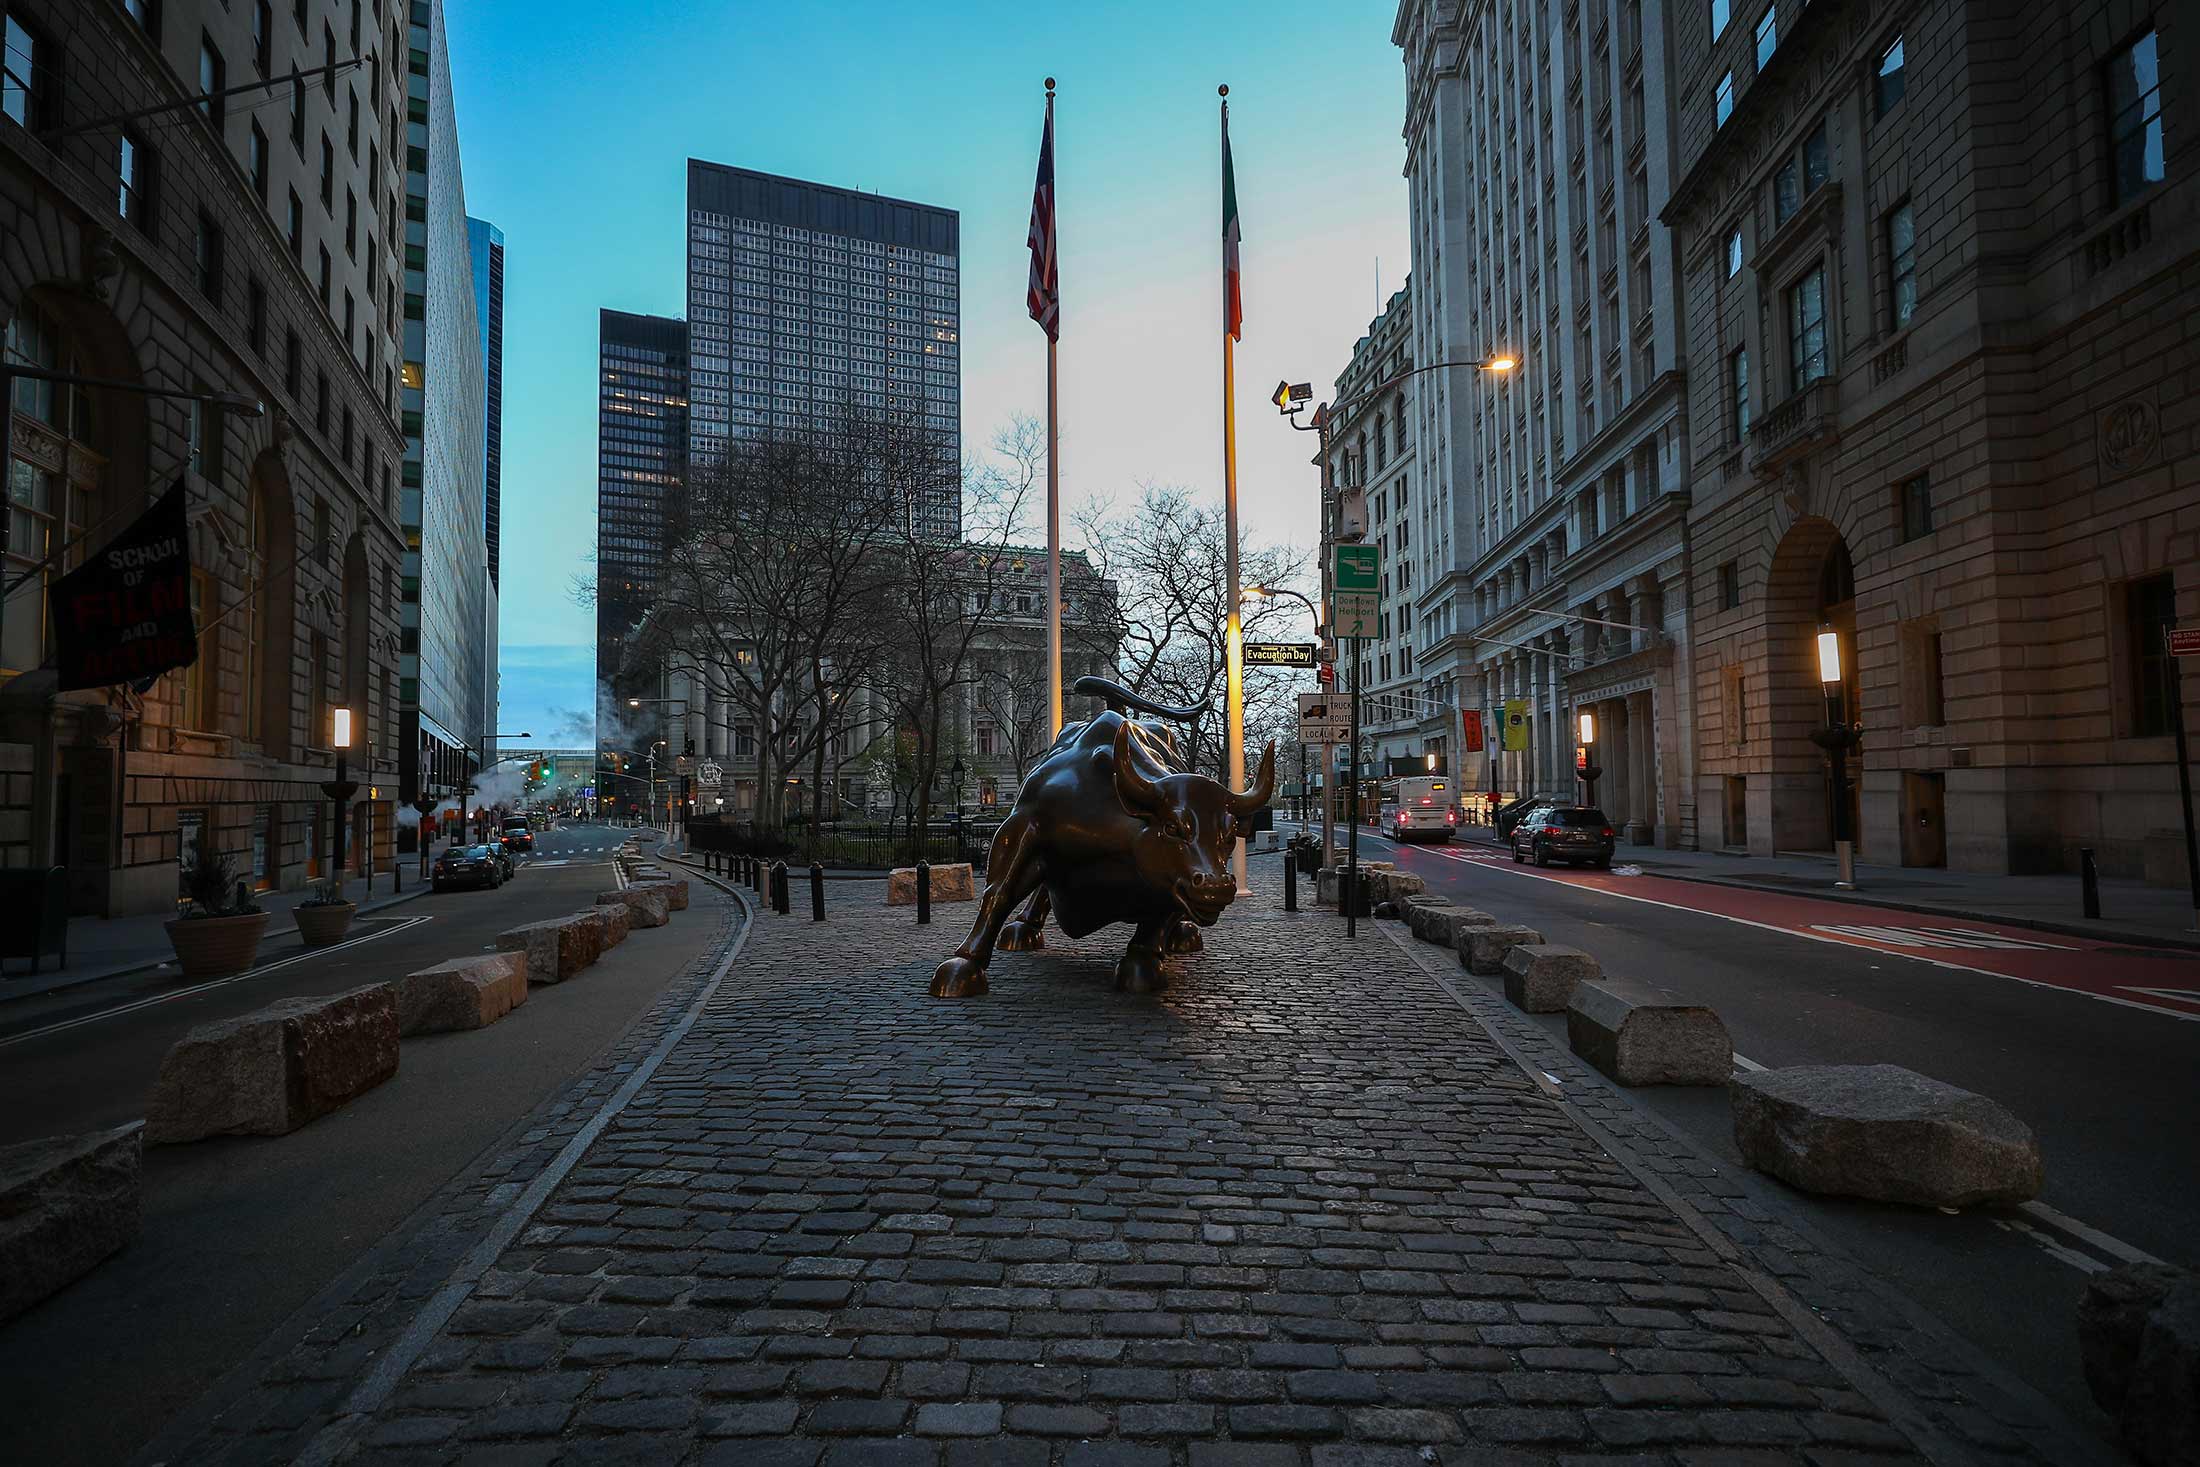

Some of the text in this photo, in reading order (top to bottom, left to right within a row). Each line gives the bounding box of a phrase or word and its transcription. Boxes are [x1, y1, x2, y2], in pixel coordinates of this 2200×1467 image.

[107, 537, 180, 569] SCHOOL
[123, 569, 145, 587] OF
[1247, 649, 1293, 660] Evacuation
[1294, 650, 1309, 662] Day
[1330, 702, 1353, 710] TRUCK
[1330, 714, 1353, 723] ROUTE
[1305, 730, 1328, 738] LOCAL
